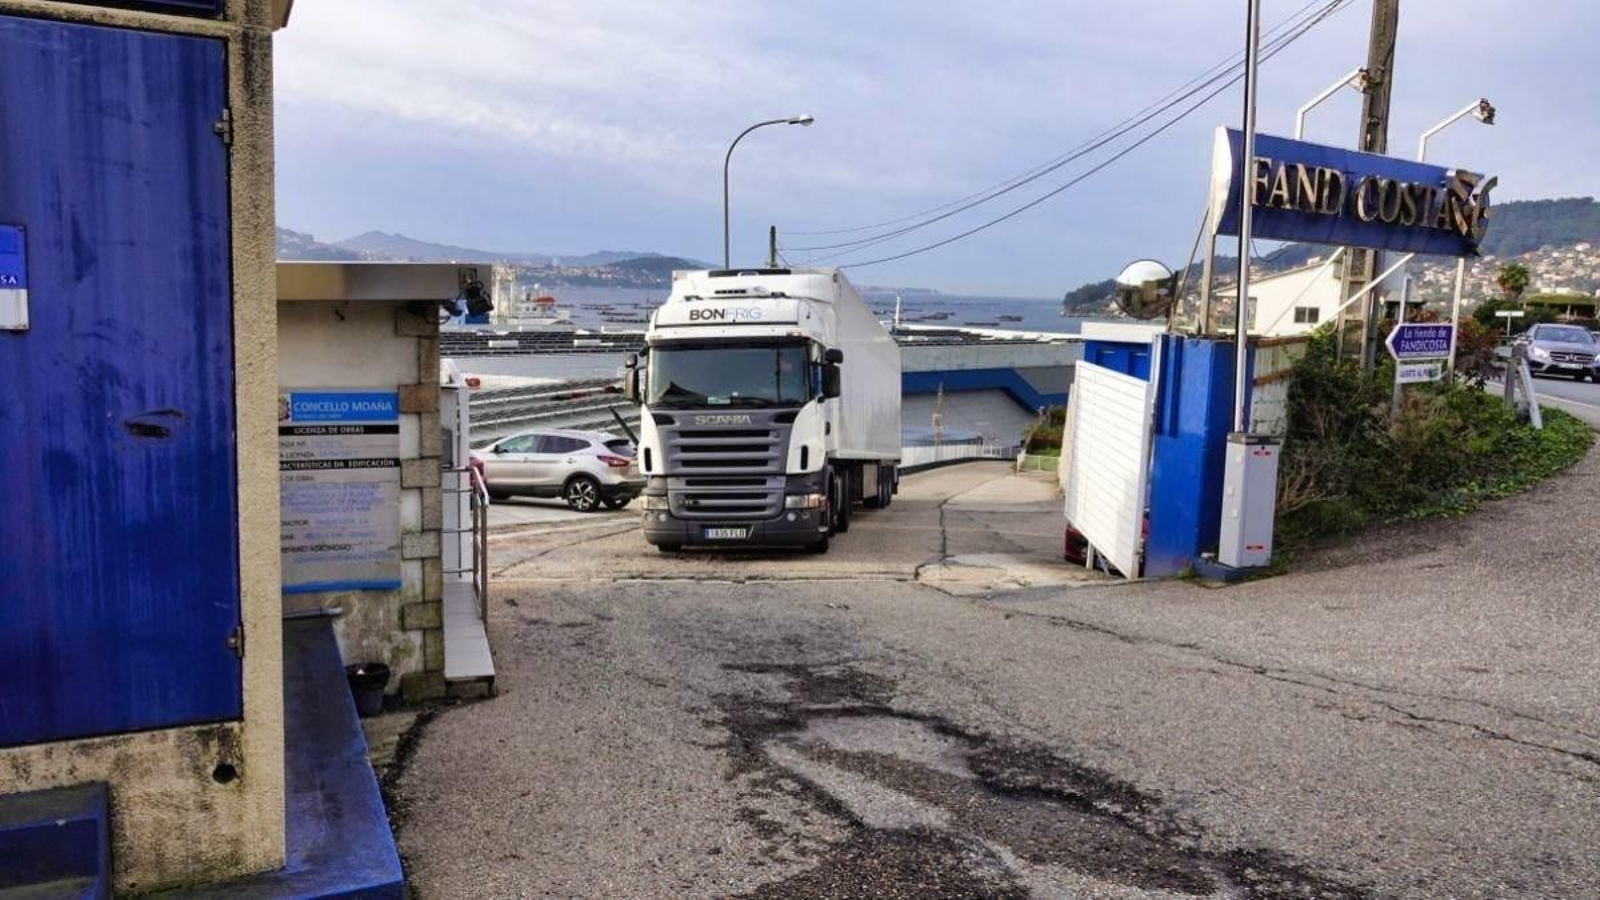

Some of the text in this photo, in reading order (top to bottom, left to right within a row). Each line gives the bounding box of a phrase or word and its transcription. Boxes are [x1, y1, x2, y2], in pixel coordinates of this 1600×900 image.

[690, 308, 762, 320] BONFRIG
[1401, 340, 1447, 352] FANDICOSTA
[293, 400, 393, 412] CONCELLO MOAÑA
[694, 415, 753, 425] SCANIA
